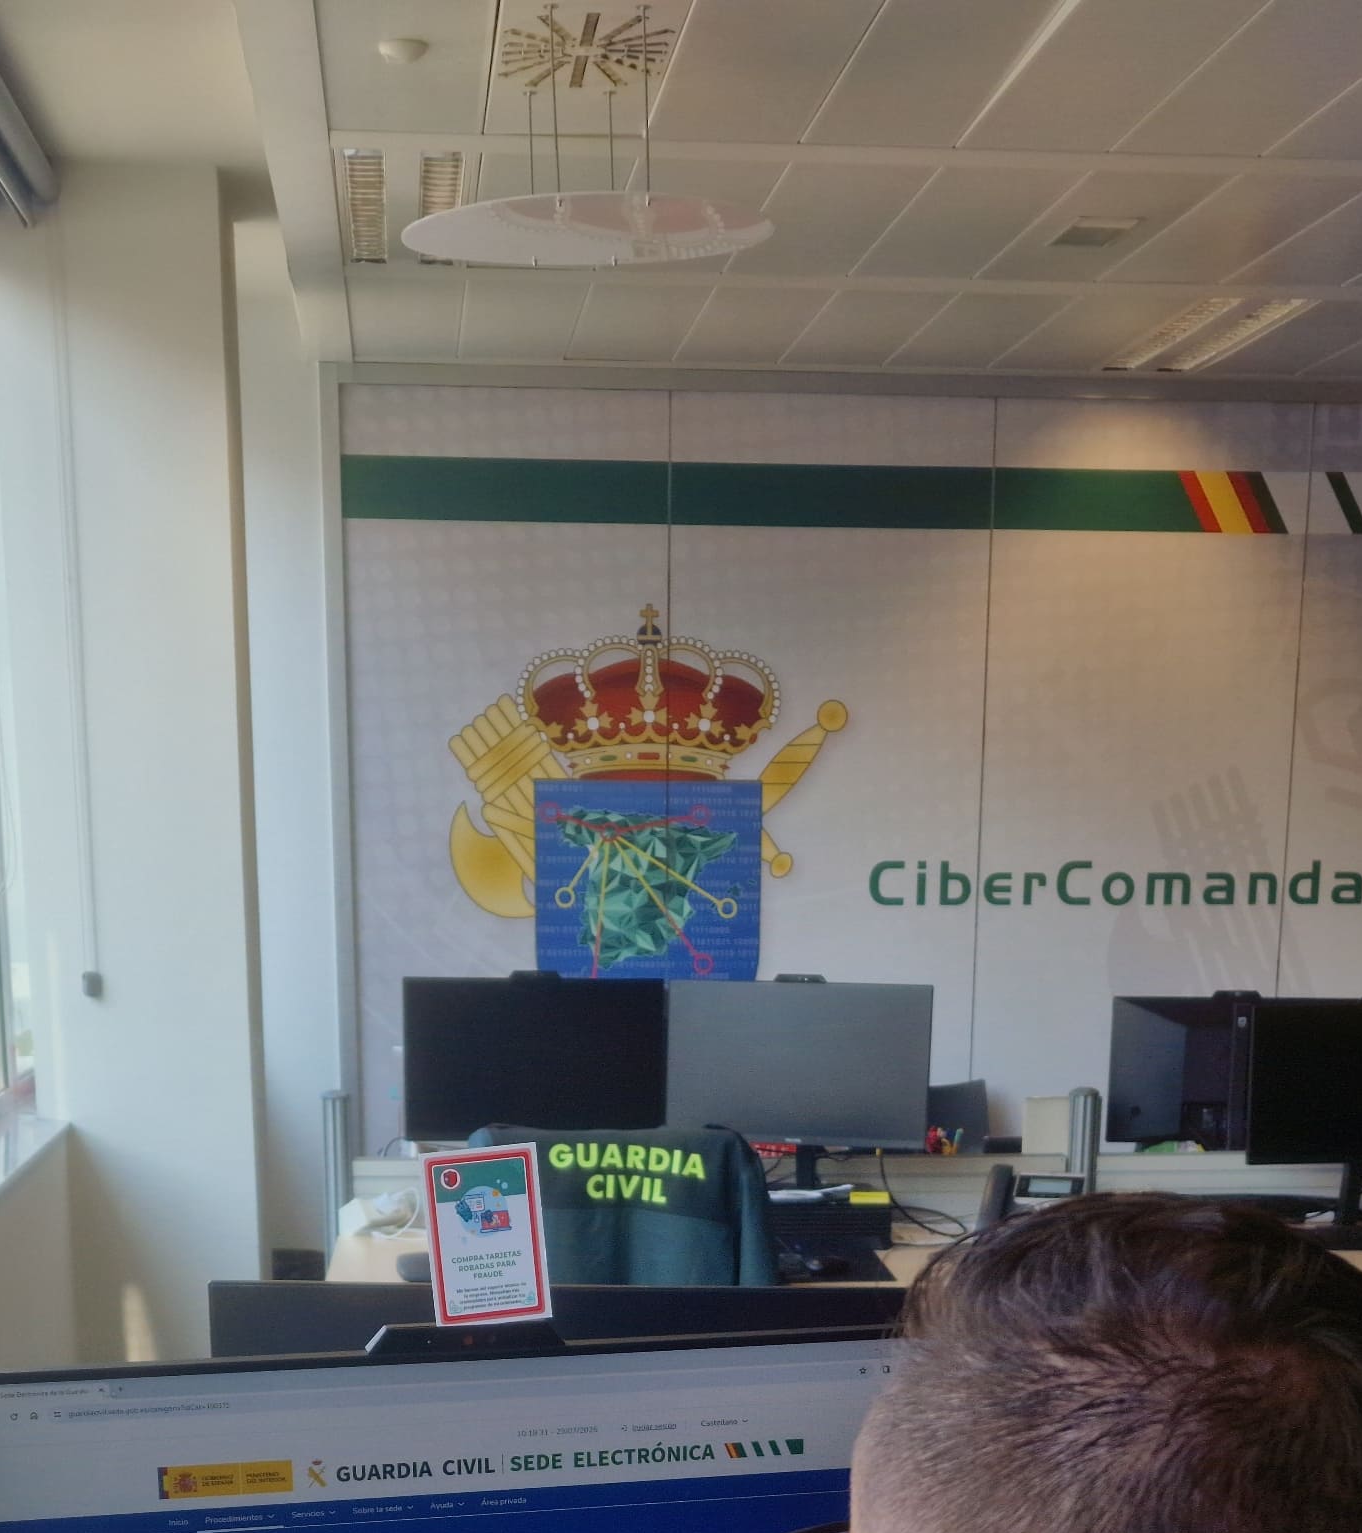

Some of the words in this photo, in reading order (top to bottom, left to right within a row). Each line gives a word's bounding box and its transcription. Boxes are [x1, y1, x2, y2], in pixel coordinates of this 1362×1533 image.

[548, 1142, 706, 1179] GUARDIA
[586, 1173, 668, 1205] CIVIL
[451, 1254, 484, 1264] COMPRA
[485, 1250, 522, 1260] TARJETAS
[458, 1262, 495, 1272] ROBADAS
[496, 1260, 517, 1268] PARA
[473, 1270, 505, 1279] FRAUDE
[700, 1418, 738, 1428] Castellano
[336, 1461, 433, 1482] GUARDIA
[442, 1457, 495, 1476] CIVIL
[509, 1453, 563, 1472] SEDE
[573, 1441, 716, 1468] ELECTRÓNICA
[430, 1501, 454, 1511] Ayuda
[480, 1497, 499, 1506] Área
[499, 1497, 527, 1507] privada
[291, 1509, 325, 1519] Servicios
[352, 1506, 375, 1514] Sobre
[385, 1504, 403, 1512] sede
[168, 1518, 189, 1527] Inicio
[205, 1513, 263, 1524] Procedimientos
